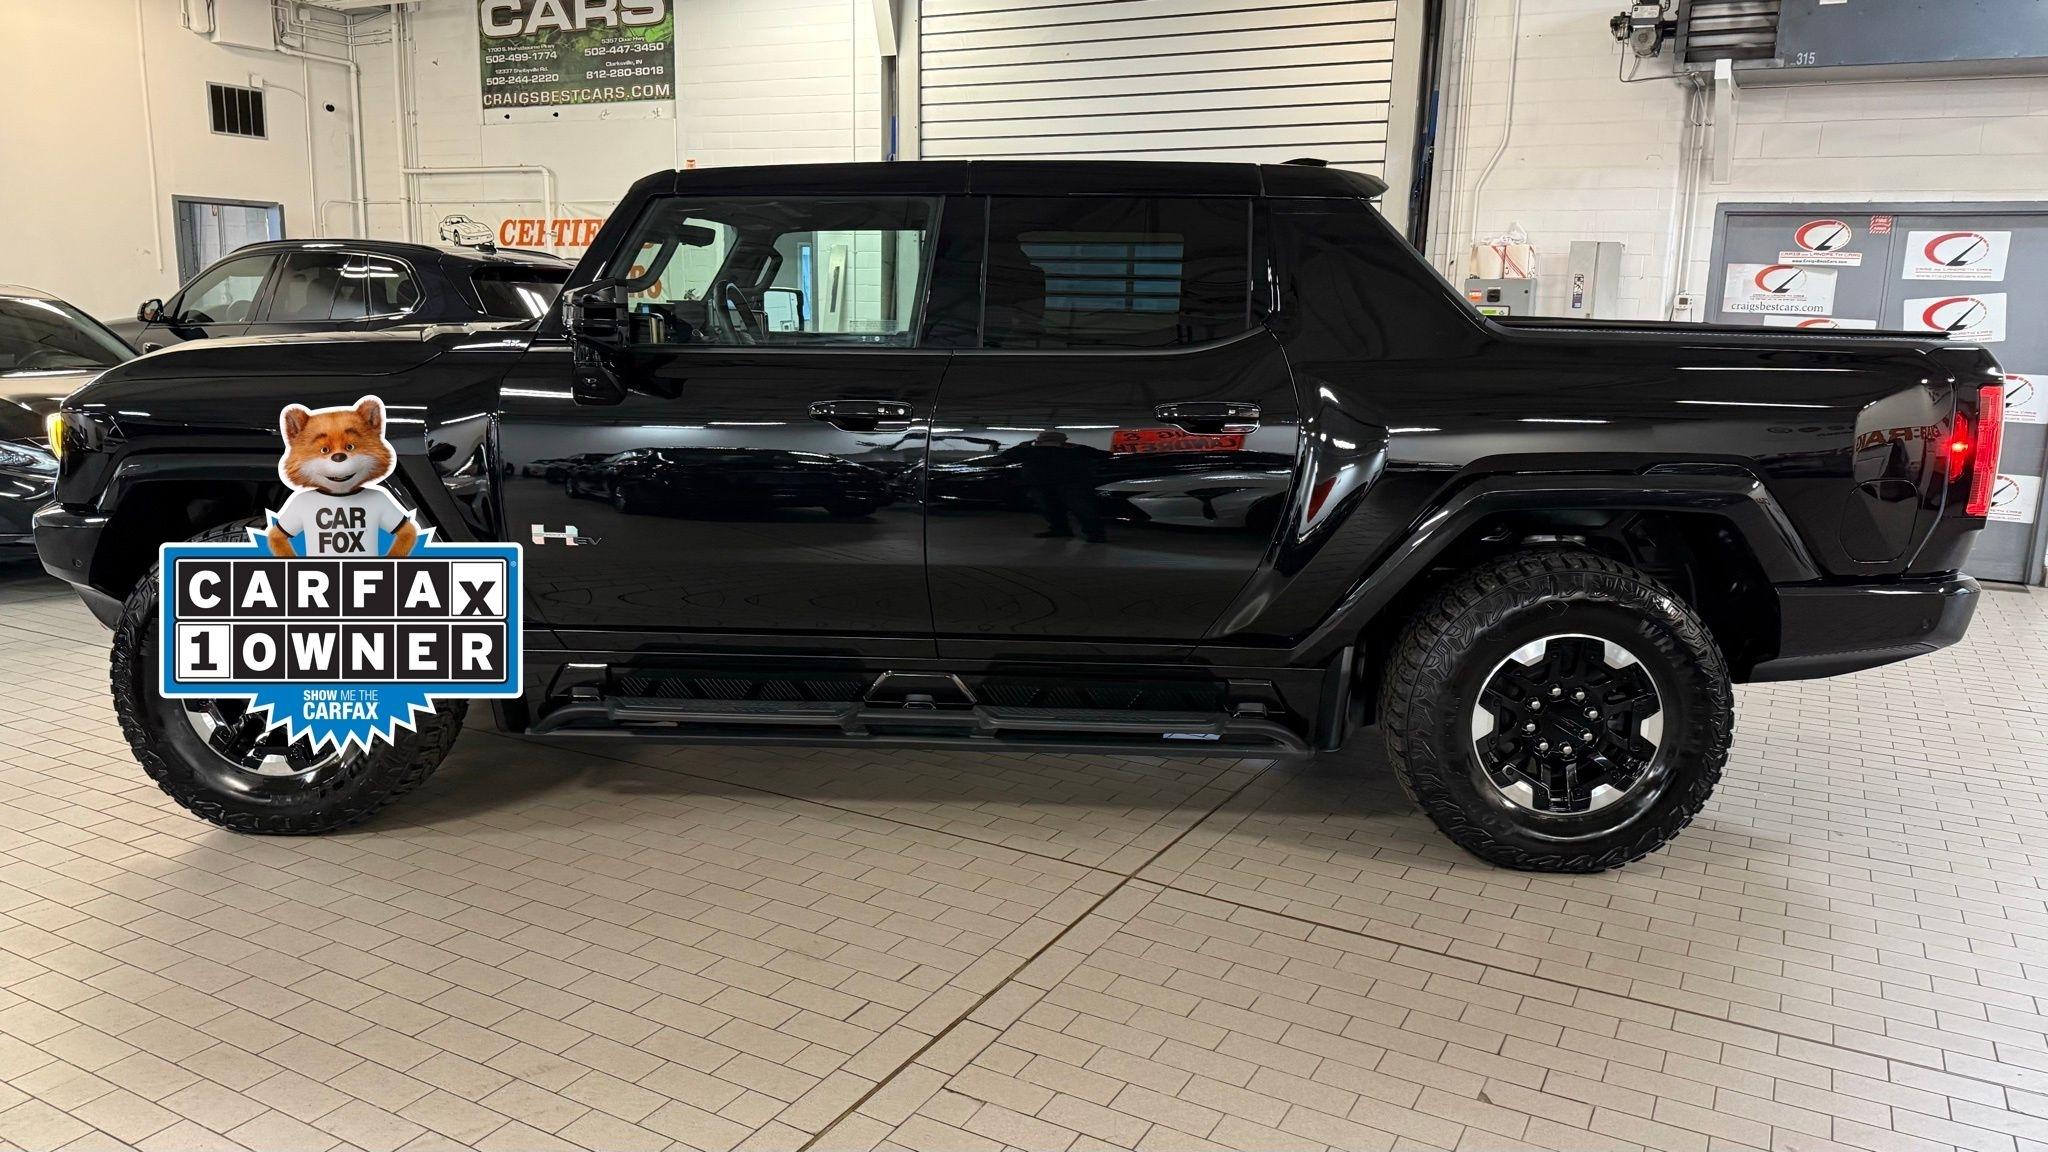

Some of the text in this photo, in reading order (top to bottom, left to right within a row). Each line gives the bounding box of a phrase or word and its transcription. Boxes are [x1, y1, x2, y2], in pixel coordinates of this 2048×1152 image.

[480, 0, 665, 38] CARS
[584, 42, 664, 57] 502-447-3450
[485, 51, 557, 64] 502-499-1774
[1796, 51, 1816, 65] 315
[486, 73, 559, 86] 502-244-2220
[586, 66, 664, 80] 812-280-8018
[483, 84, 670, 106] CRAIGSBESTCARS.COM
[1731, 301, 1824, 313] craigsbestcars.com
